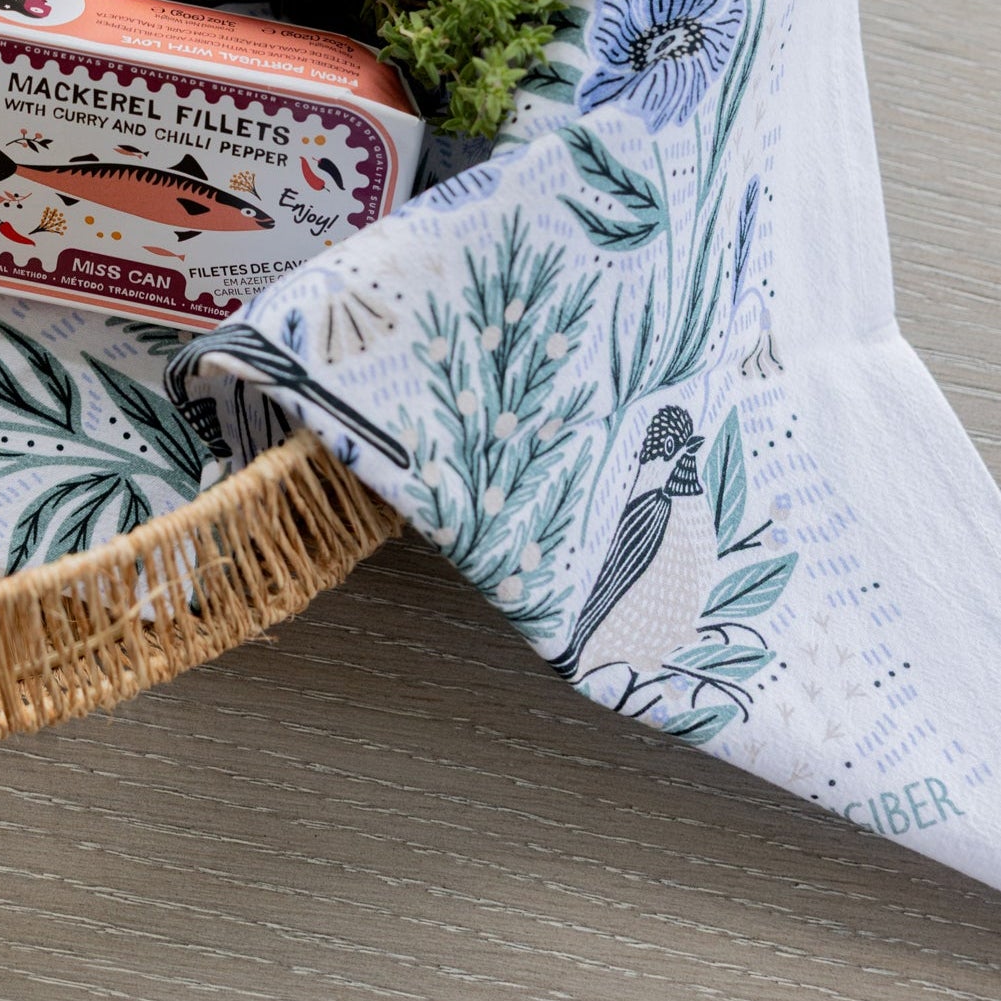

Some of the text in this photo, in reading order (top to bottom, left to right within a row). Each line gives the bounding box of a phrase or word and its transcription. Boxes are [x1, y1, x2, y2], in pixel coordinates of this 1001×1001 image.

[121, 33, 161, 50] LOVE
[167, 40, 212, 58] WITH
[310, 67, 359, 87] FROM
[24, 45, 102, 67] CONSERVAS
[108, 61, 124, 71] DE
[130, 66, 206, 88] QUALIDADE
[212, 83, 277, 103] SUPERIOR
[294, 101, 363, 128] CONSERVES
[364, 129, 377, 142] DE
[8, 72, 291, 146] MACKEREL FILLETS
[4, 98, 289, 167] WITH CURRY AND CHILLI PEPPER
[279, 187, 340, 236] Enjoy!
[72, 257, 172, 290] MISS CAN
[189, 264, 248, 279] FILETES
[250, 262, 272, 274] DE
[223, 278, 238, 287] EM
[240, 275, 275, 286] AZEITE
[13, 267, 48, 281] METHOD
[61, 275, 104, 291] MÉTODO
[108, 285, 177, 307] TRADICIONAL
[214, 287, 243, 297] CARIL
[244, 287, 252, 295] E
